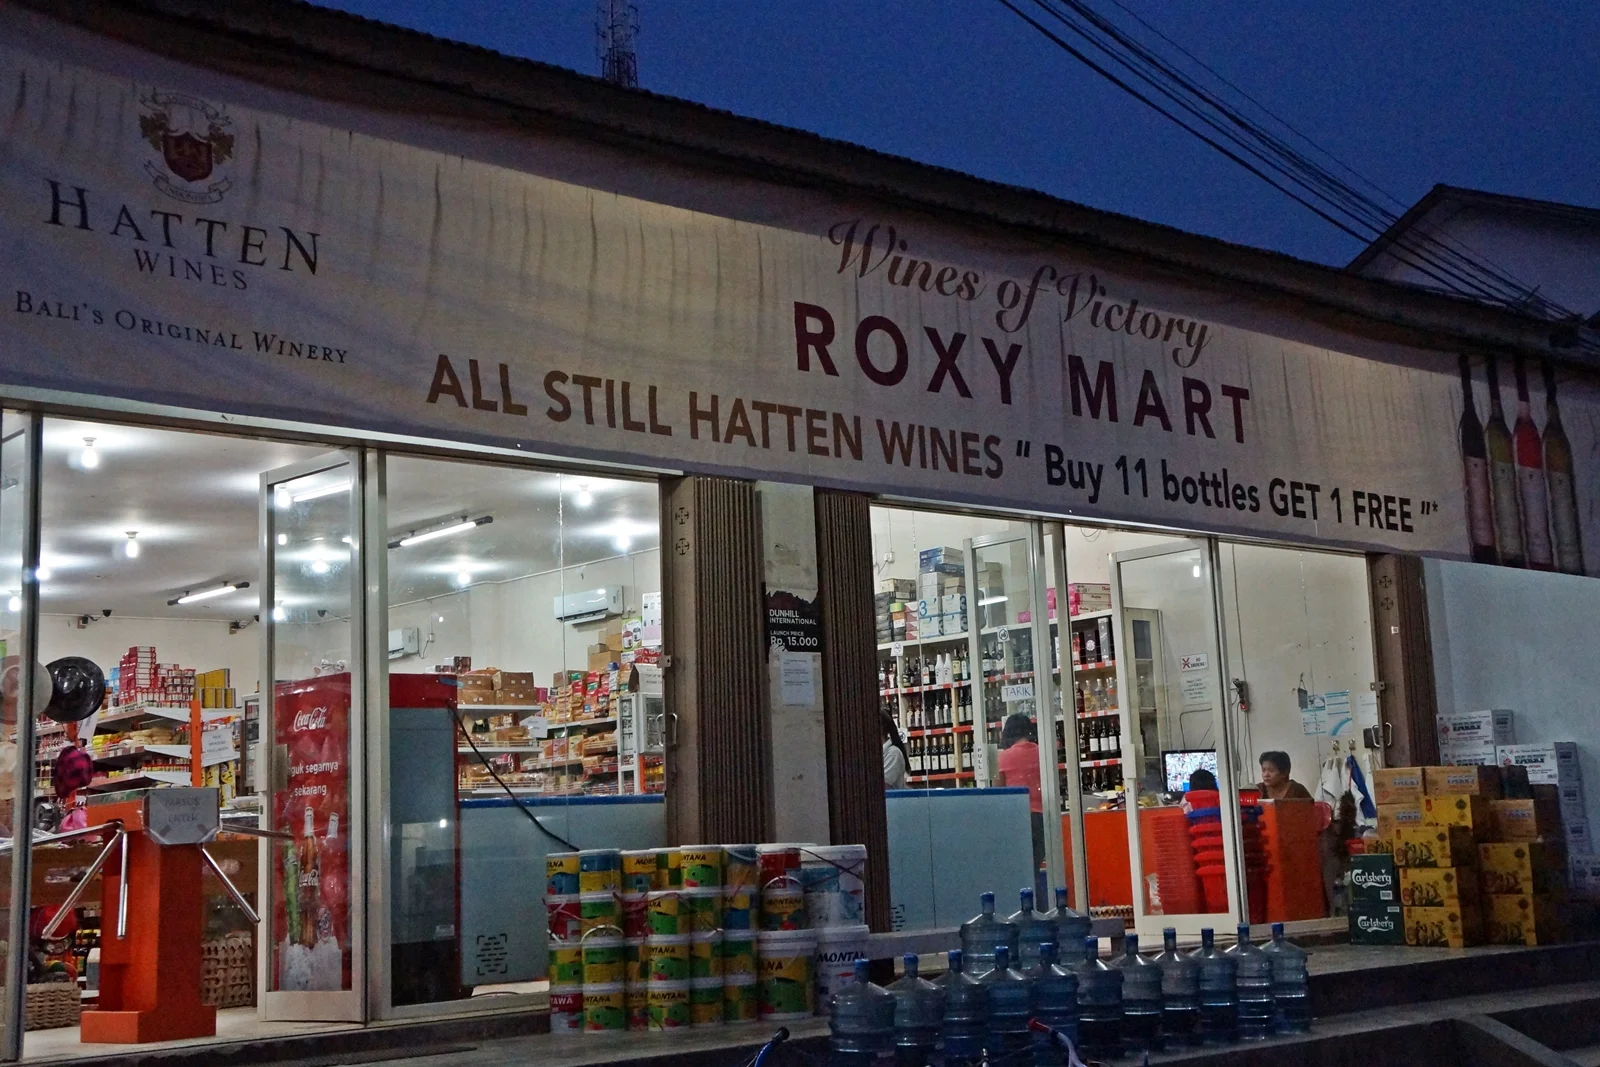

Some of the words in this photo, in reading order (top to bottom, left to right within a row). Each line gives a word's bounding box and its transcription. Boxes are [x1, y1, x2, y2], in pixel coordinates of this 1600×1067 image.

[45, 178, 321, 276] HATTEN
[133, 248, 249, 291] WINES
[828, 219, 986, 300] Wines
[996, 265, 1059, 333] of
[1056, 271, 1212, 368] Victory
[15, 290, 104, 326] BALI'S
[115, 309, 243, 350] ORIGINAL
[252, 331, 348, 364] WINERY
[793, 300, 1023, 405] ROXY
[1067, 354, 1250, 444] MART
[426, 353, 528, 417] ALL
[543, 369, 672, 437] STILL
[689, 390, 863, 461] HATTEN
[876, 418, 1004, 480] WINES
[1045, 443, 1104, 504] Buy
[1115, 455, 1149, 498] 11
[1163, 458, 1261, 514] bottles
[1269, 477, 1322, 522] GET
[1330, 487, 1343, 524] 1
[1353, 490, 1414, 534] FREE
[769, 608, 800, 618] DUNHILL
[919, 600, 928, 617] 3
[769, 617, 817, 626] INTERNATIONAL
[787, 636, 819, 648] 15.000
[1004, 686, 1032, 698] TARIK
[289, 763, 305, 777] guk
[305, 760, 339, 775] segarnya
[294, 783, 328, 796] sekarang
[1351, 868, 1392, 888] Carlsberg
[1357, 915, 1394, 932] Carlsberg
